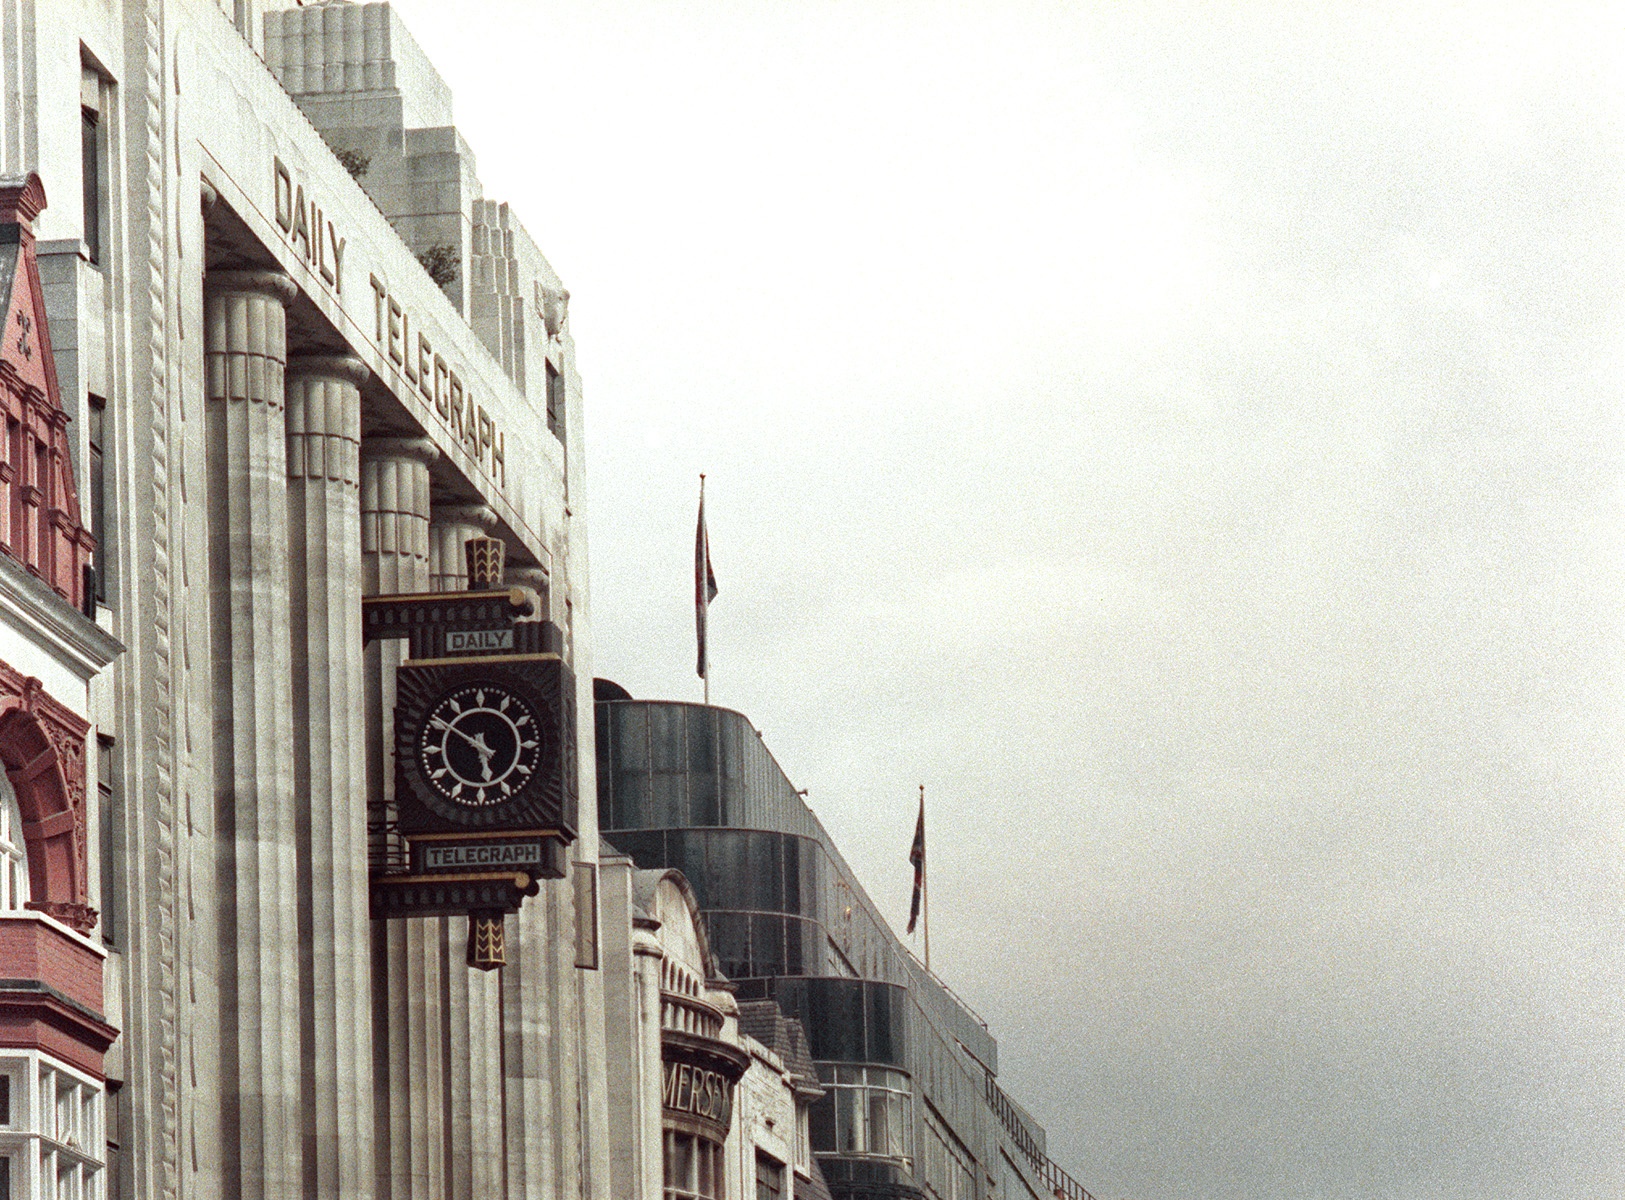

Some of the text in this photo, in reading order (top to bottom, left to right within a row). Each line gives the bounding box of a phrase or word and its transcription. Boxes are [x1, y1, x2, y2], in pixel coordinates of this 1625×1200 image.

[274, 155, 504, 488] DAILY TELEGRAPH
[452, 632, 507, 649] DAILY
[430, 847, 538, 864] TELEGRAPH
